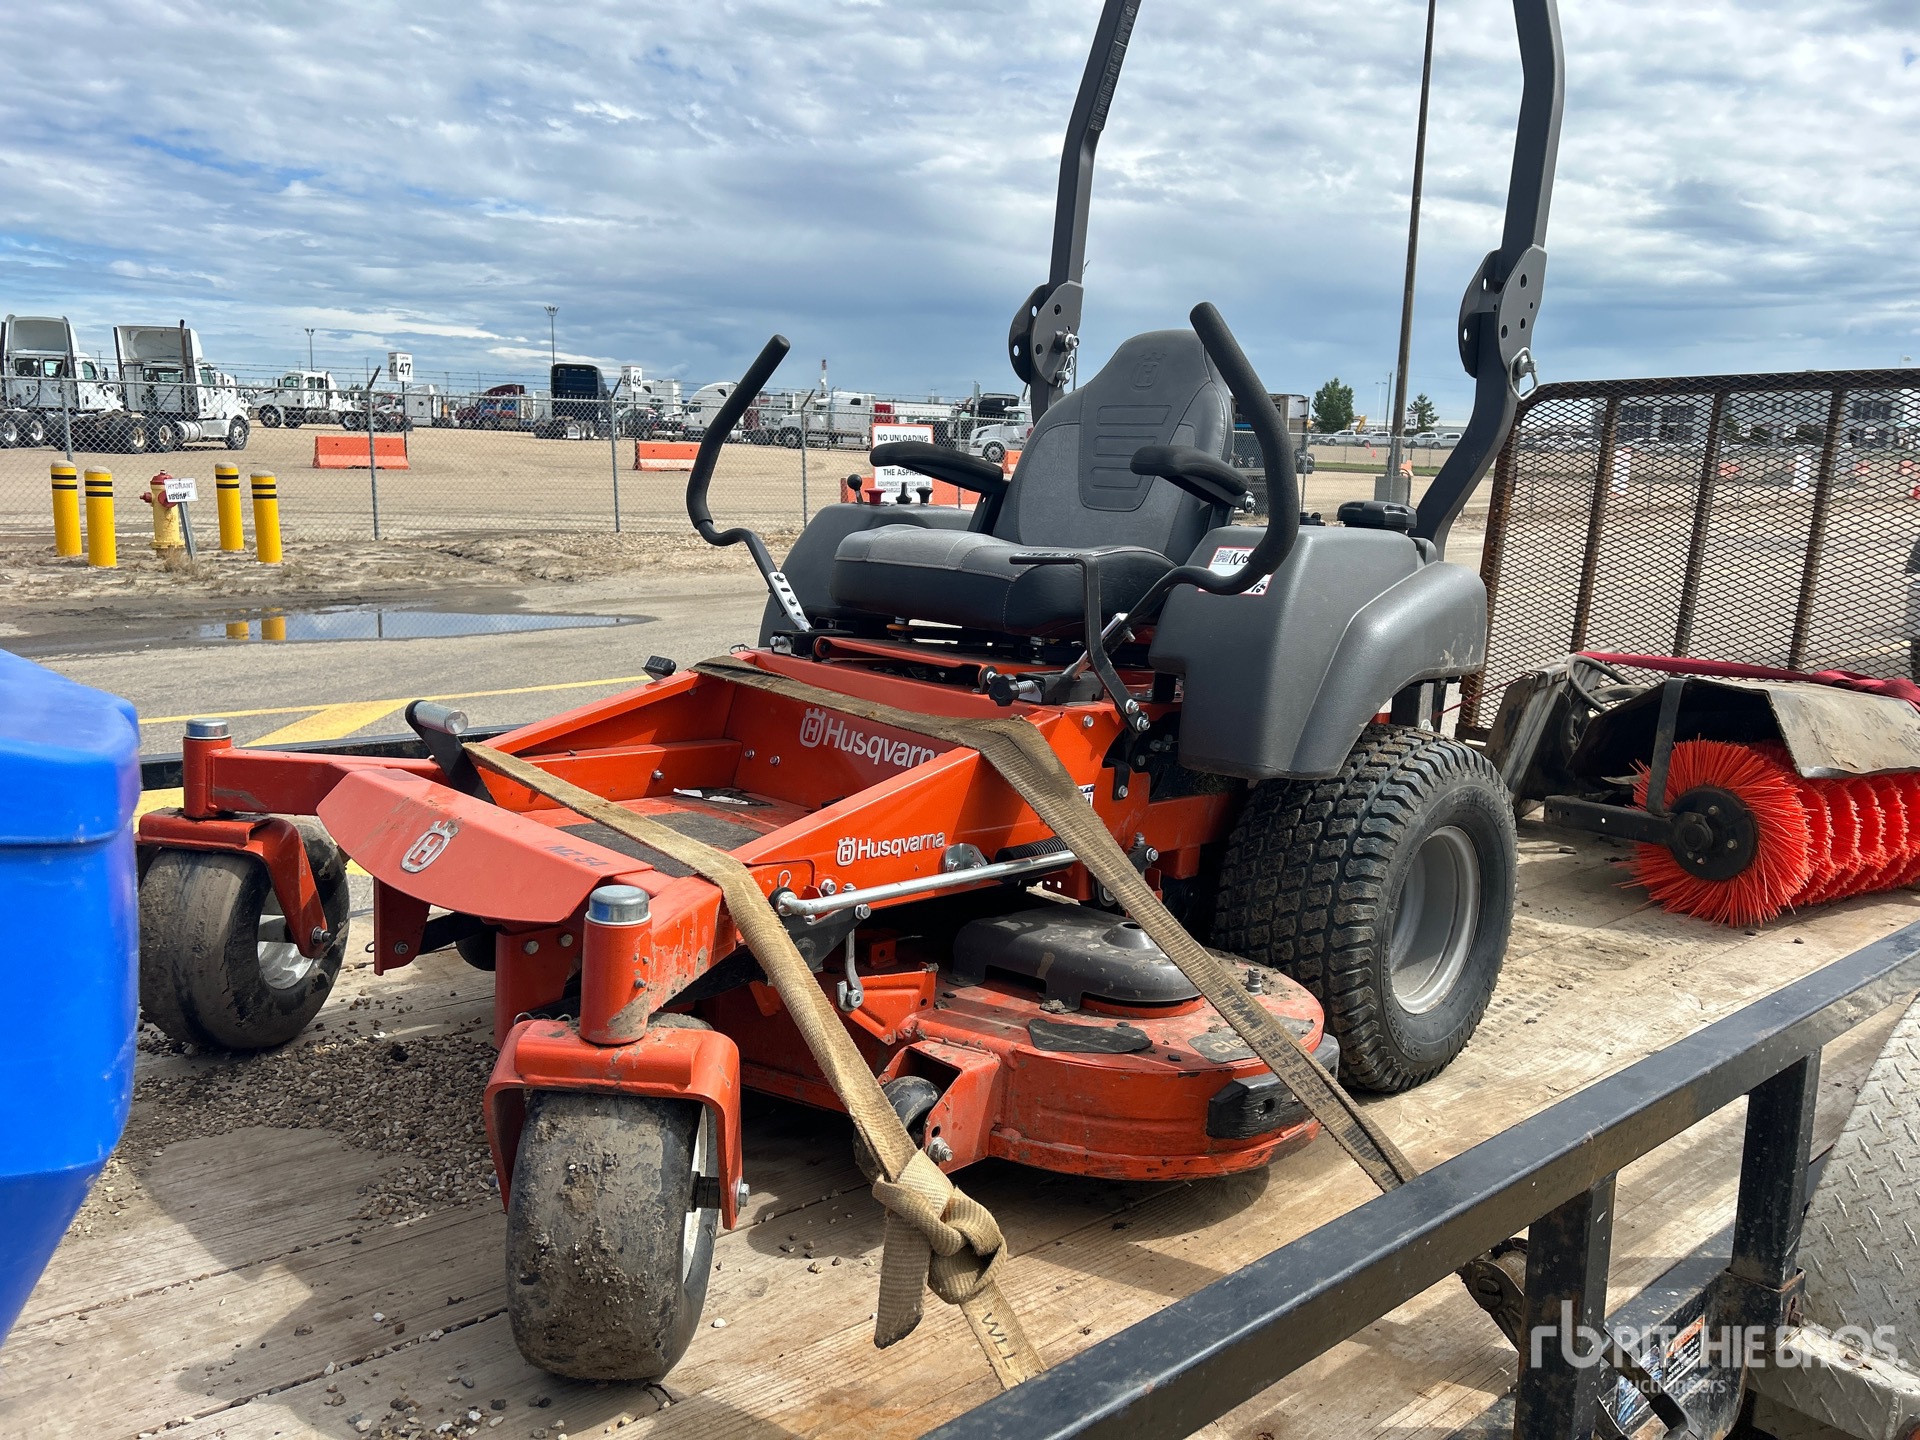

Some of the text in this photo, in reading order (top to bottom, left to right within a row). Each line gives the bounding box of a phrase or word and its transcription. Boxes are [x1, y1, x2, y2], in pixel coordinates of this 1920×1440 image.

[399, 362, 411, 376] 47
[622, 374, 631, 387] 46
[632, 375, 642, 387] 46
[877, 433, 929, 443] NO UNLOADING
[882, 468, 896, 476] THE
[823, 717, 946, 769] Husqvarn
[857, 831, 946, 860] Husqvarna
[981, 1312, 1016, 1369] WLL
